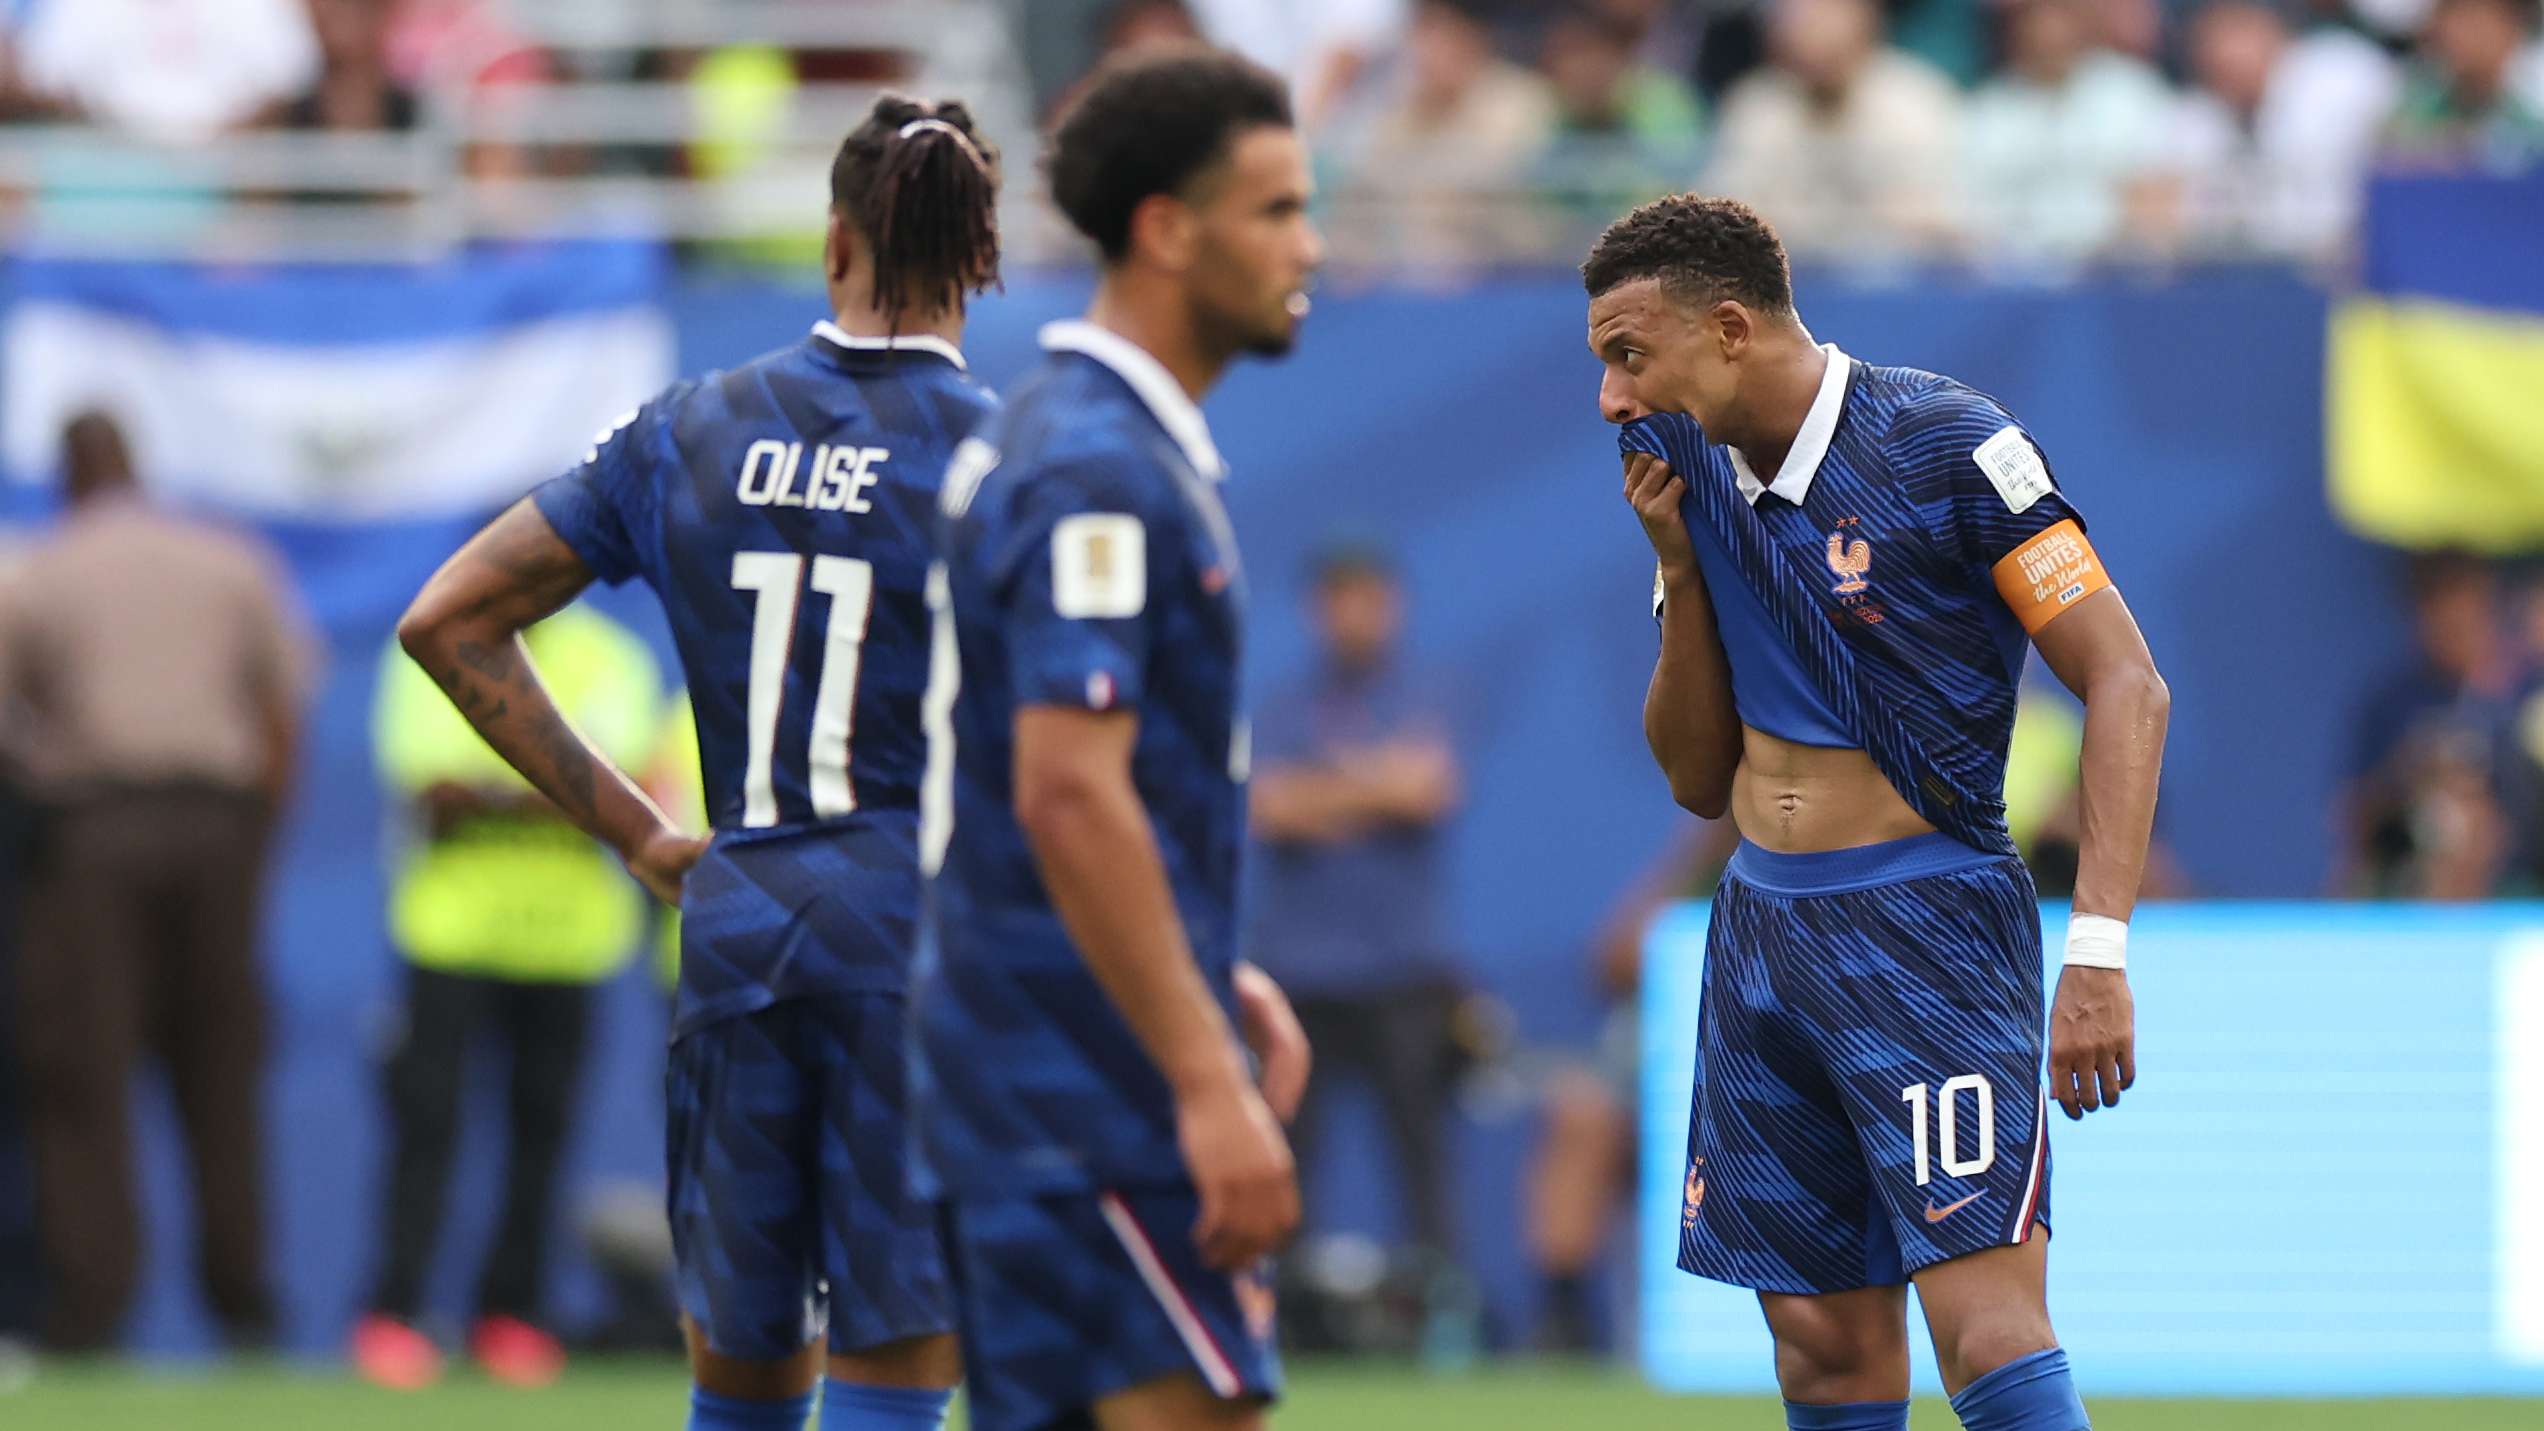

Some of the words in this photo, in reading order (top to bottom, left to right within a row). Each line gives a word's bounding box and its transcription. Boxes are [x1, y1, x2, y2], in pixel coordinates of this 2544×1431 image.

[737, 440, 890, 514] OLISE
[1999, 448, 2031, 477] UNITES
[2016, 530, 2073, 569] FOOTBALL
[2025, 540, 2083, 585] UNITES
[2033, 582, 2057, 603] the
[2054, 557, 2094, 588] World
[2061, 585, 2082, 602] FIFA
[731, 551, 873, 829] 11
[1902, 1073, 1996, 1187] 10
